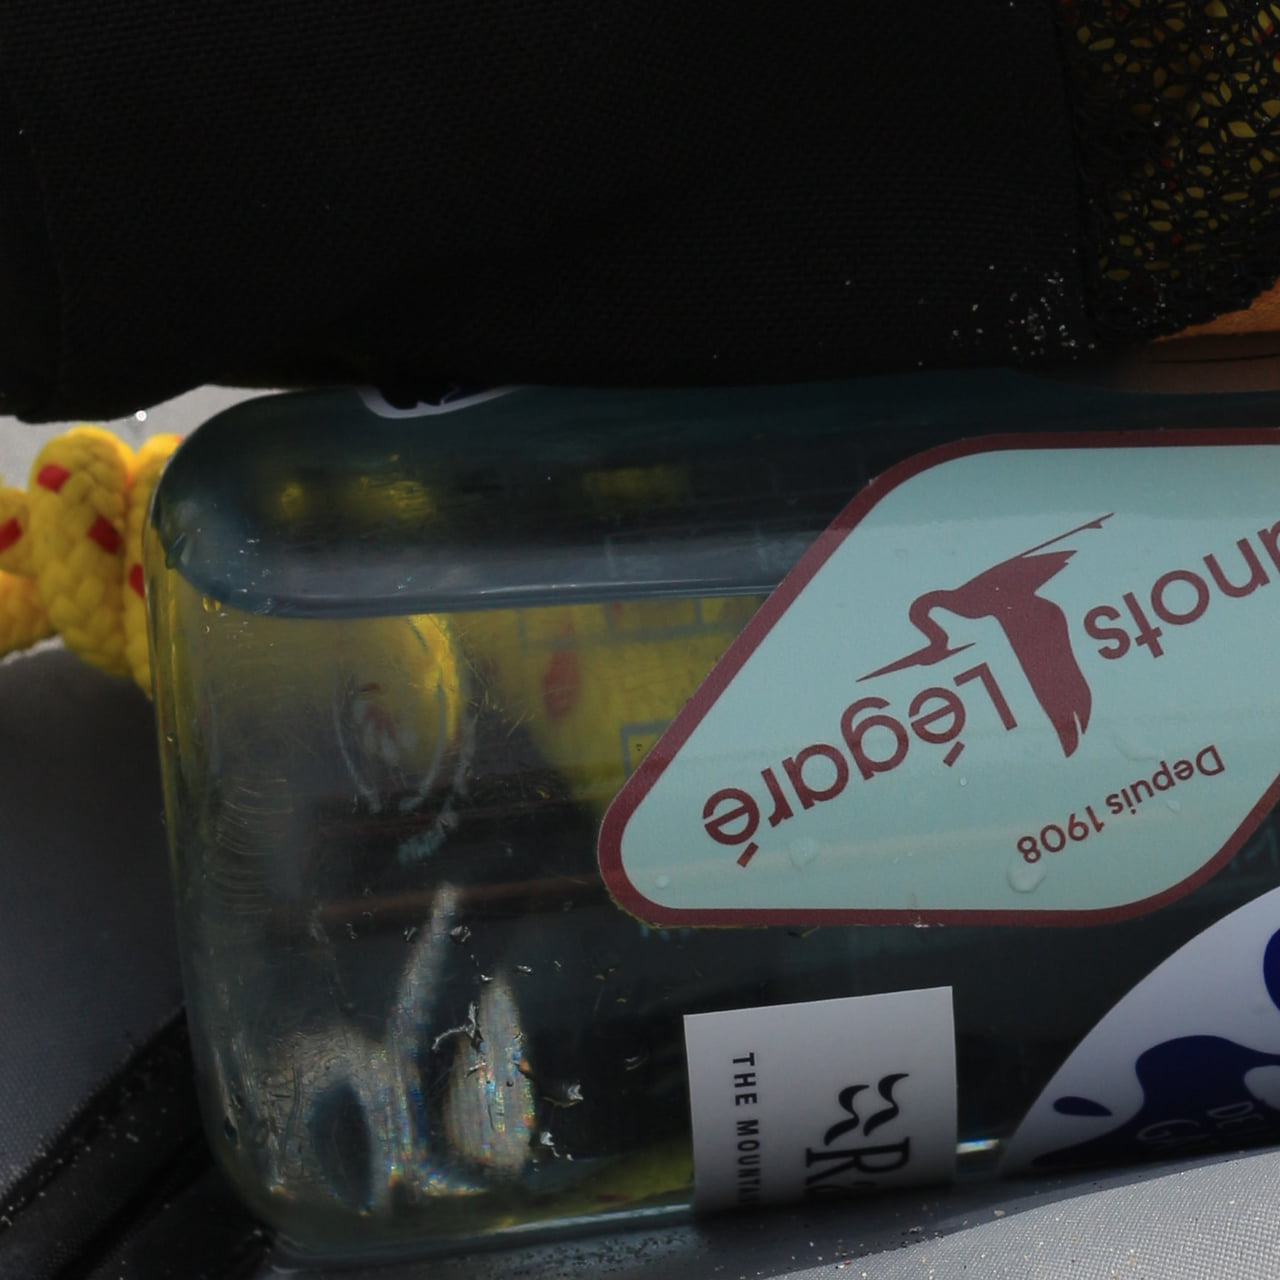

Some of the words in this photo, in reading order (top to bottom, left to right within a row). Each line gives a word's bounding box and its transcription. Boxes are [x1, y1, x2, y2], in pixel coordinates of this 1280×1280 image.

[701, 661, 1018, 869] Légaré
[1109, 744, 1227, 817] Depuis
[1016, 803, 1106, 865] 1908
[732, 1052, 757, 1106] THE
[736, 1119, 761, 1205] MOUNTA
